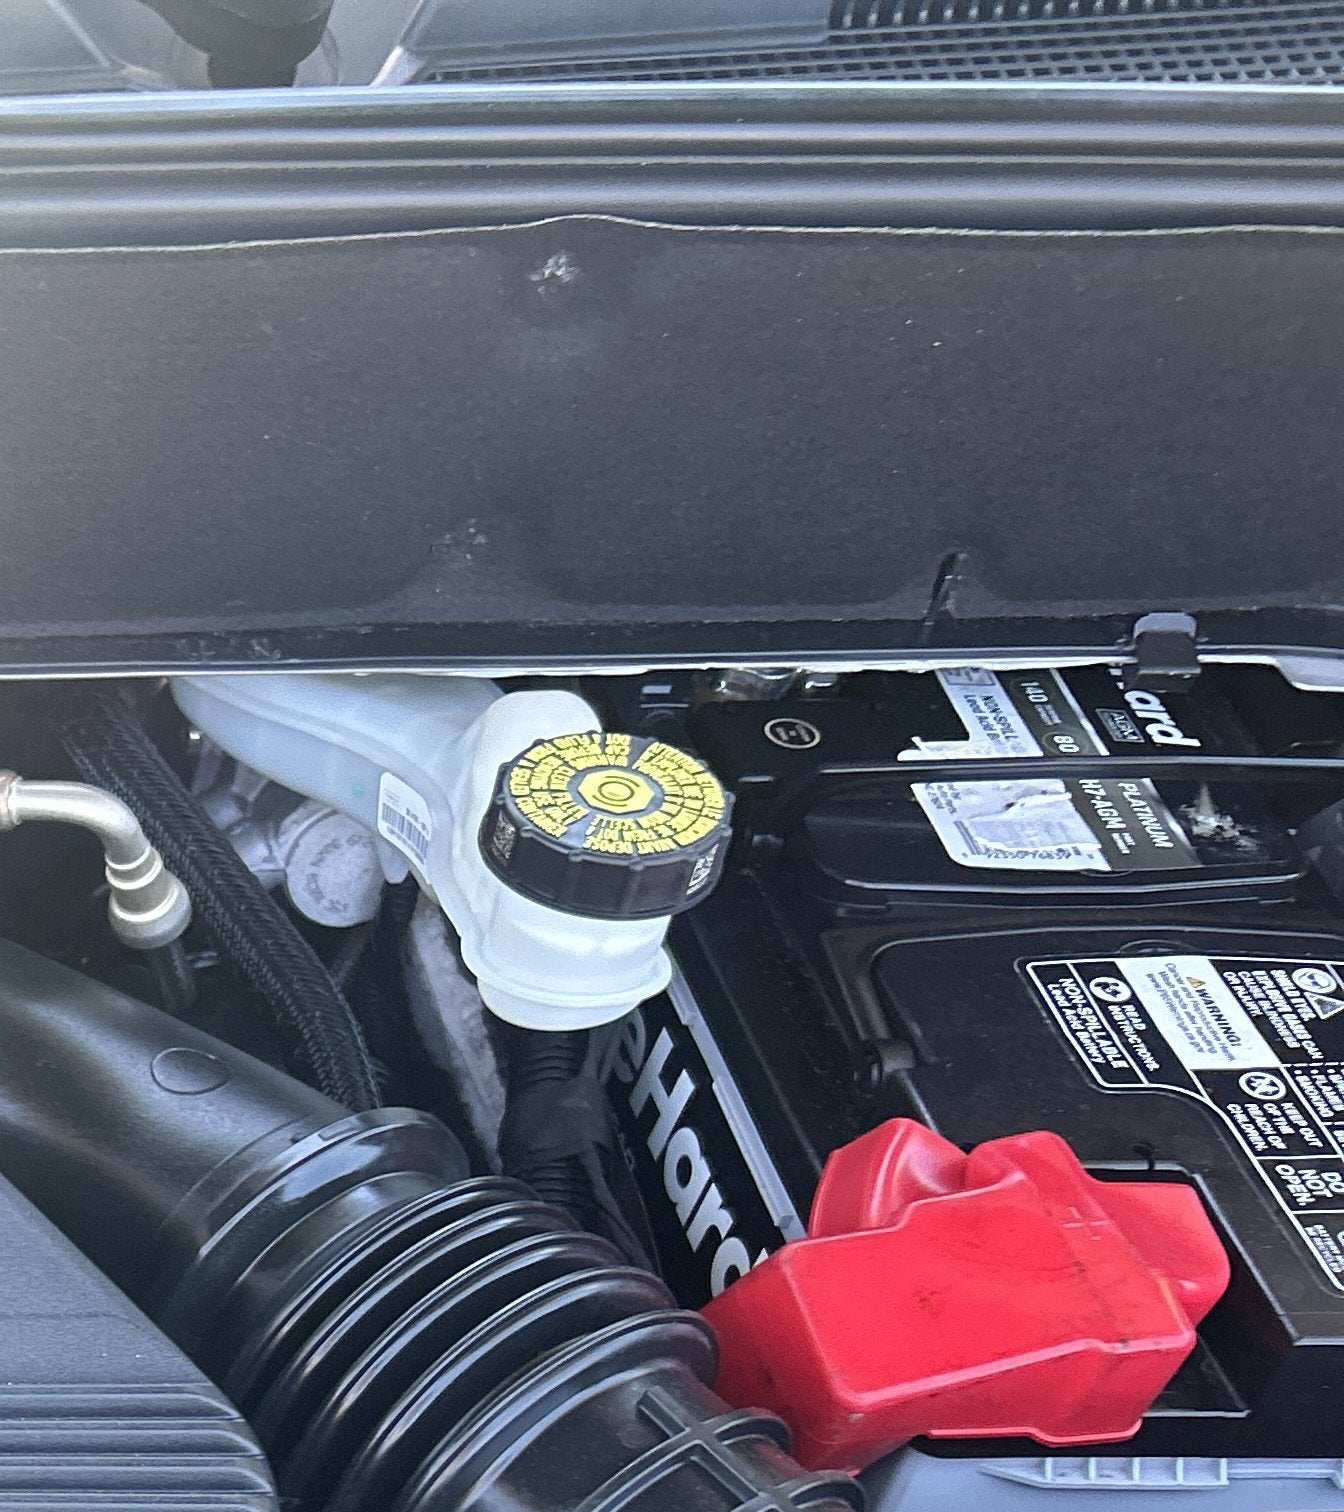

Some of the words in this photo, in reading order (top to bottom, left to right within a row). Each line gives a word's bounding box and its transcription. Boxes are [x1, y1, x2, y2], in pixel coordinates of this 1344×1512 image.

[1020, 681, 1049, 703] 140
[1052, 735, 1080, 753] 80
[1118, 782, 1174, 848] PLATINUM
[1223, 971, 1242, 985] OR
[1047, 983, 1072, 1008] Lead
[1062, 1008, 1085, 1030] Acid
[1074, 1031, 1106, 1064] Battery
[1058, 977, 1130, 1070] NON-SPILLABLE
[1121, 1004, 1147, 1031] READ
[1195, 988, 1242, 1047] WARNING!
[1301, 1040, 1324, 1060] CAN
[1263, 1102, 1282, 1116] OF
[1244, 1103, 1277, 1135] REACH
[1267, 1135, 1288, 1150] OF
[1272, 1116, 1295, 1134] THE
[1281, 1102, 1308, 1127] KEEP
[1299, 1127, 1324, 1148] OUT
[1275, 1164, 1316, 1207] OPEN.
[1298, 1169, 1333, 1198] NOT
[1321, 1171, 1344, 1193] DO
